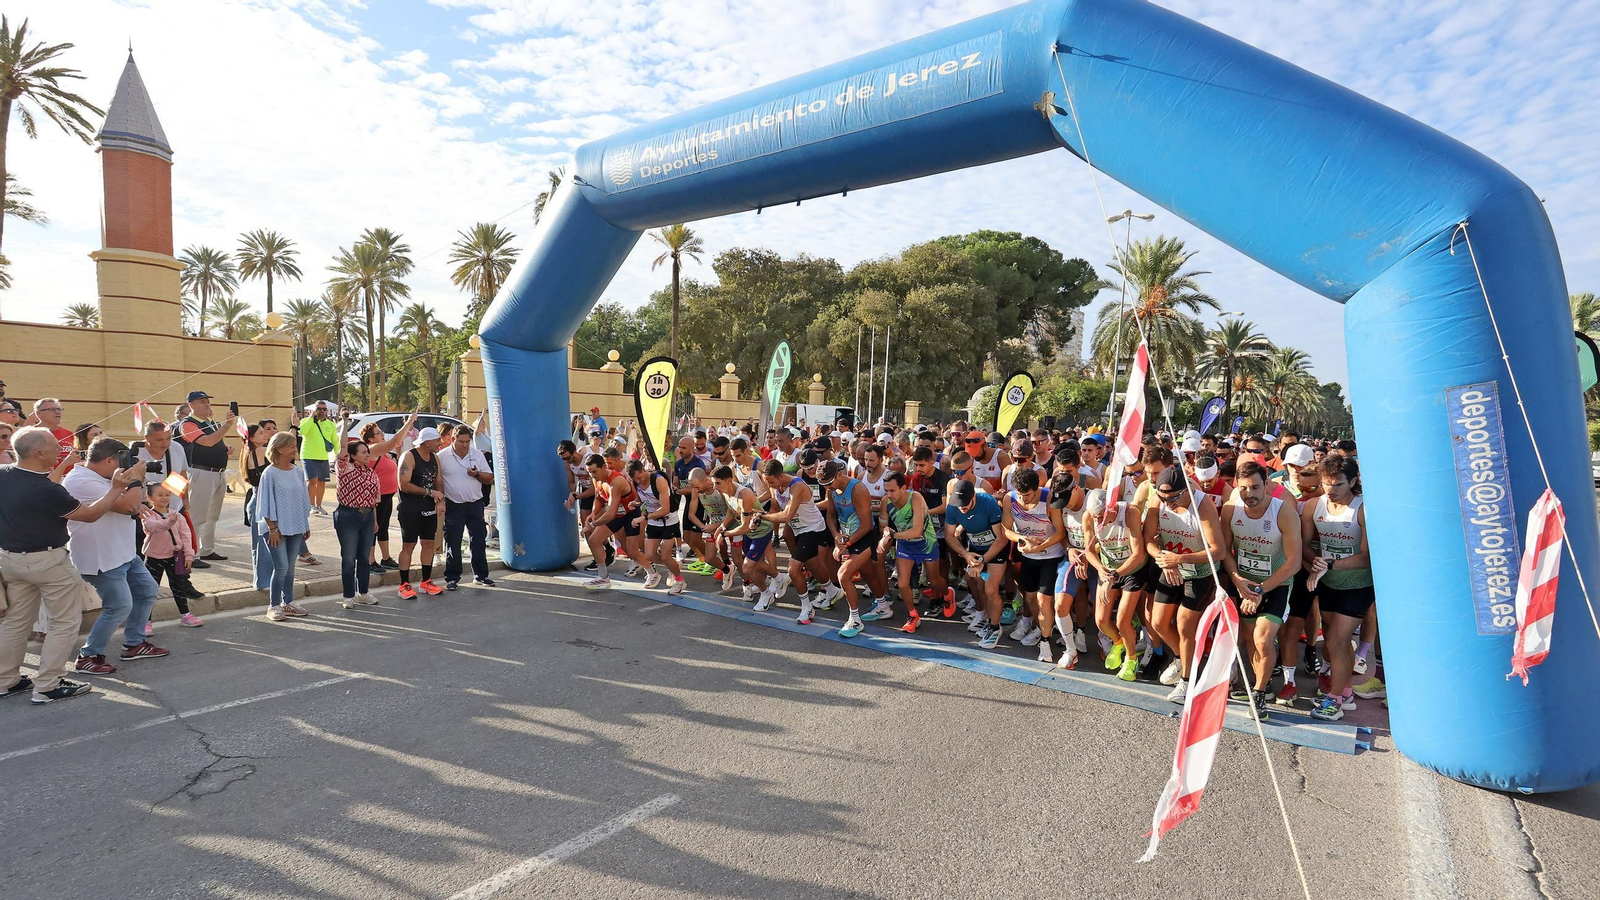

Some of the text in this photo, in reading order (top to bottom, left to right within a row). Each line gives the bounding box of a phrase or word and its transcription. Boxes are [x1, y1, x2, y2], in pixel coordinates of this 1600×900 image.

[638, 51, 982, 162] Ayuntamiento de Jerez
[639, 148, 719, 178] Deportes
[652, 376, 663, 385] 1h
[492, 400, 509, 502] deportes@aytojerez.es
[1456, 390, 1516, 628] deportes@aytojerez.es
[1235, 535, 1274, 545] maratón
[1247, 559, 1259, 569] 12
